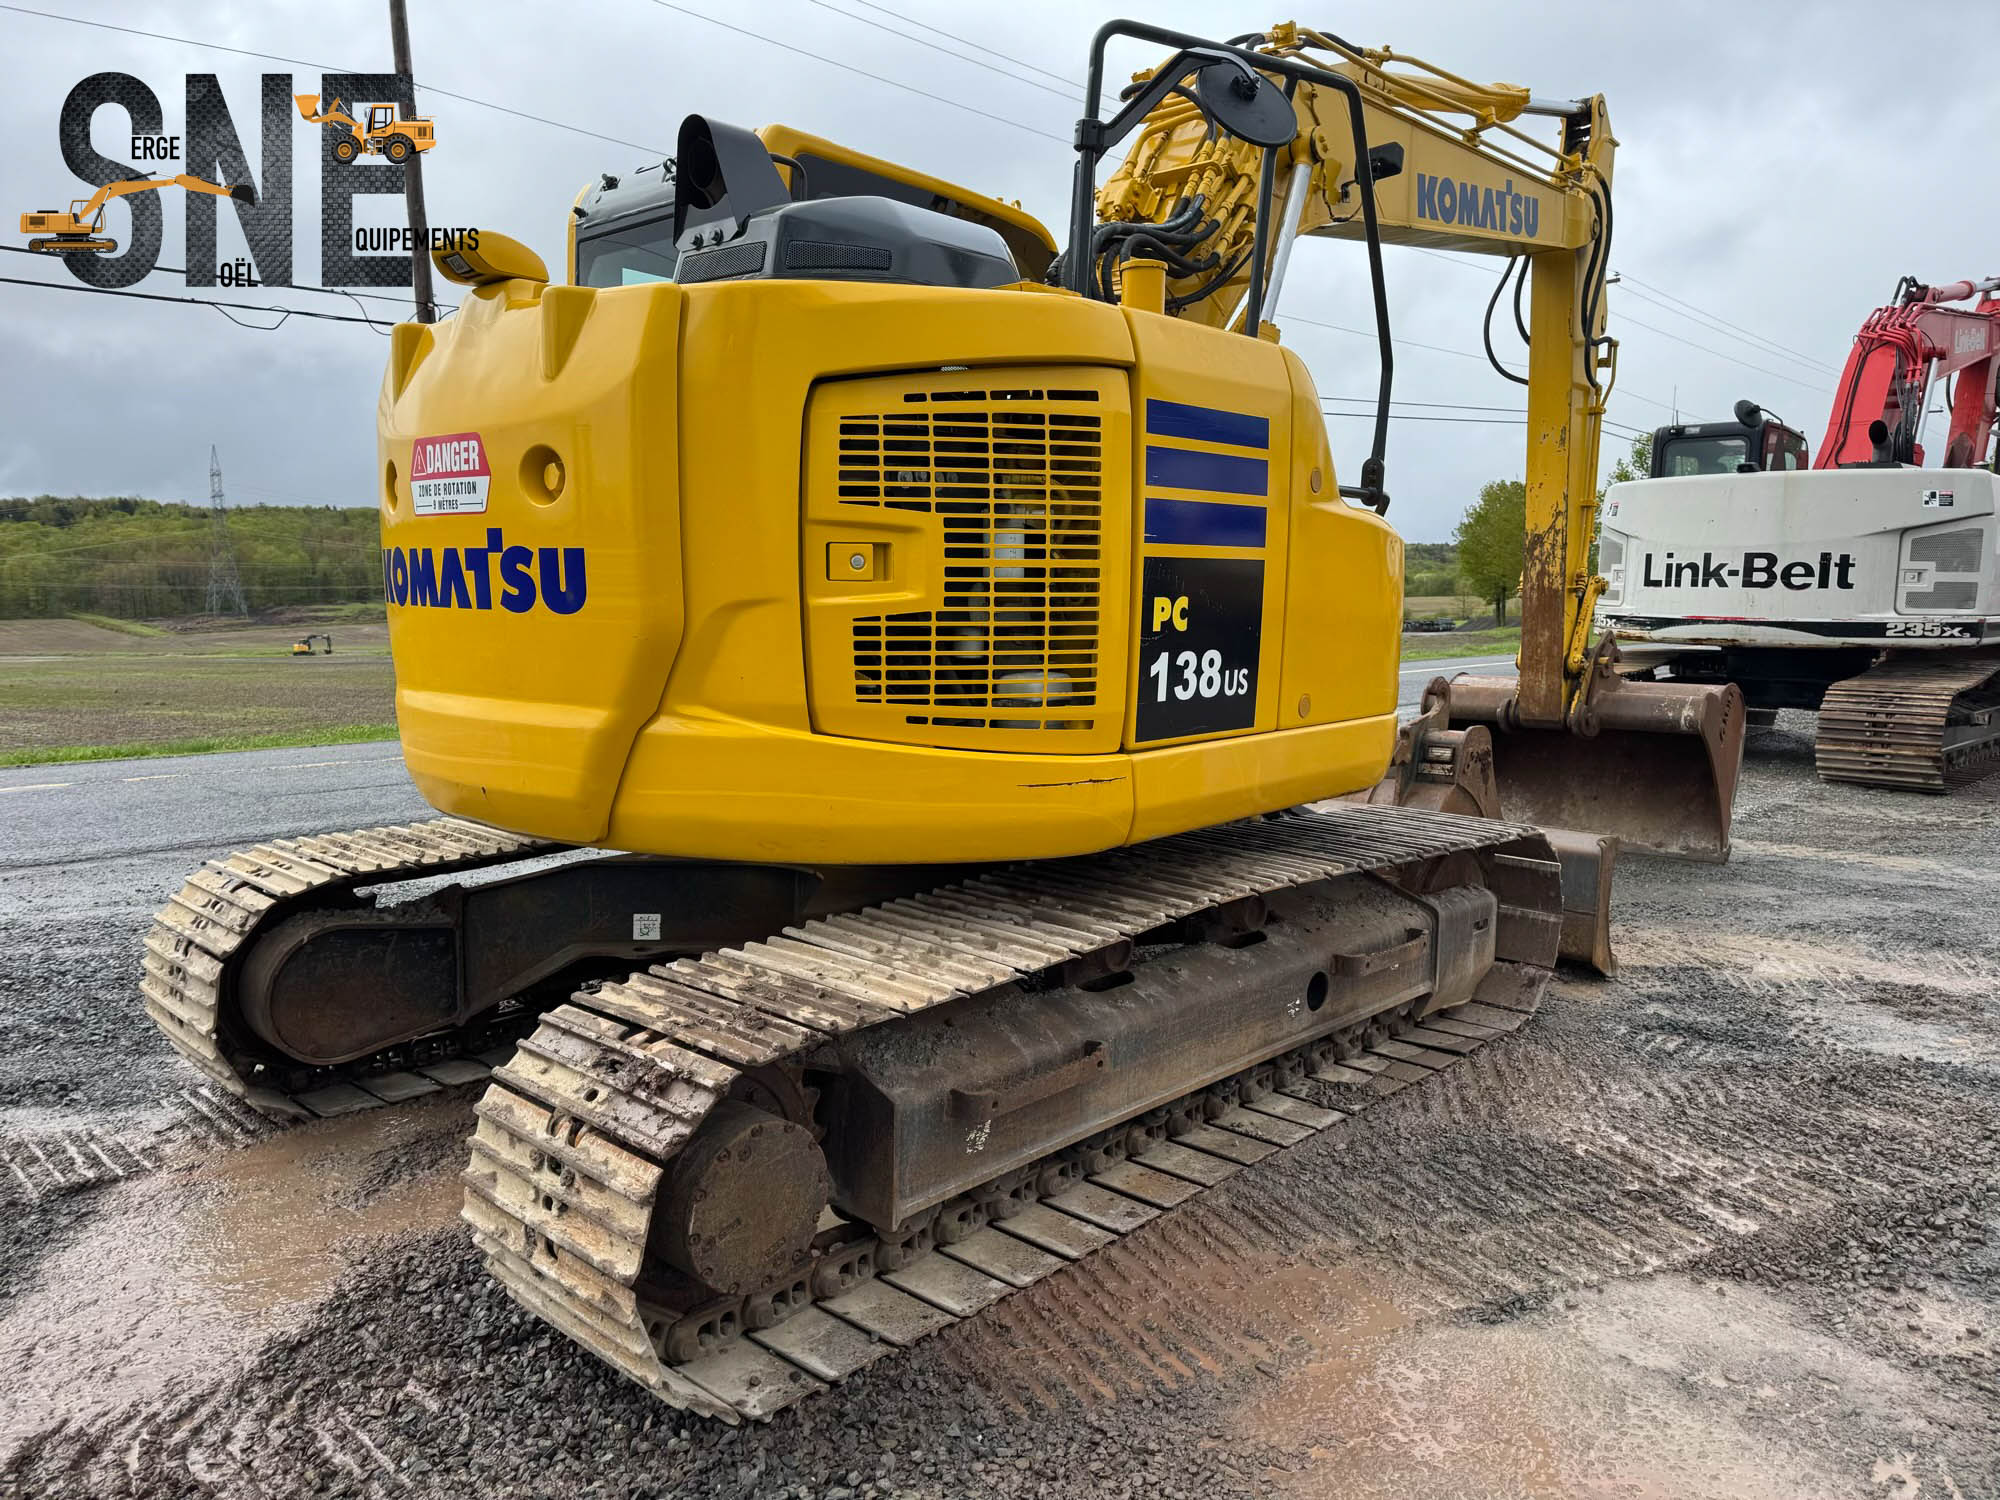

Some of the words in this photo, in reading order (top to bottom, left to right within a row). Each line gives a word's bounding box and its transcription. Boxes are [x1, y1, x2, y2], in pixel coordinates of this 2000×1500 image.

[1416, 172, 1539, 238] KOMATSU
[426, 440, 480, 473] DANGER
[418, 483, 432, 497] ZONE
[433, 482, 441, 496] DE
[443, 480, 477, 496] ROTATION
[433, 499, 437, 510] 9
[438, 497, 459, 510] MÈTRES
[383, 528, 587, 615] KOMATSU
[1643, 552, 1856, 591] Link-Belt
[1152, 595, 1189, 632] PC
